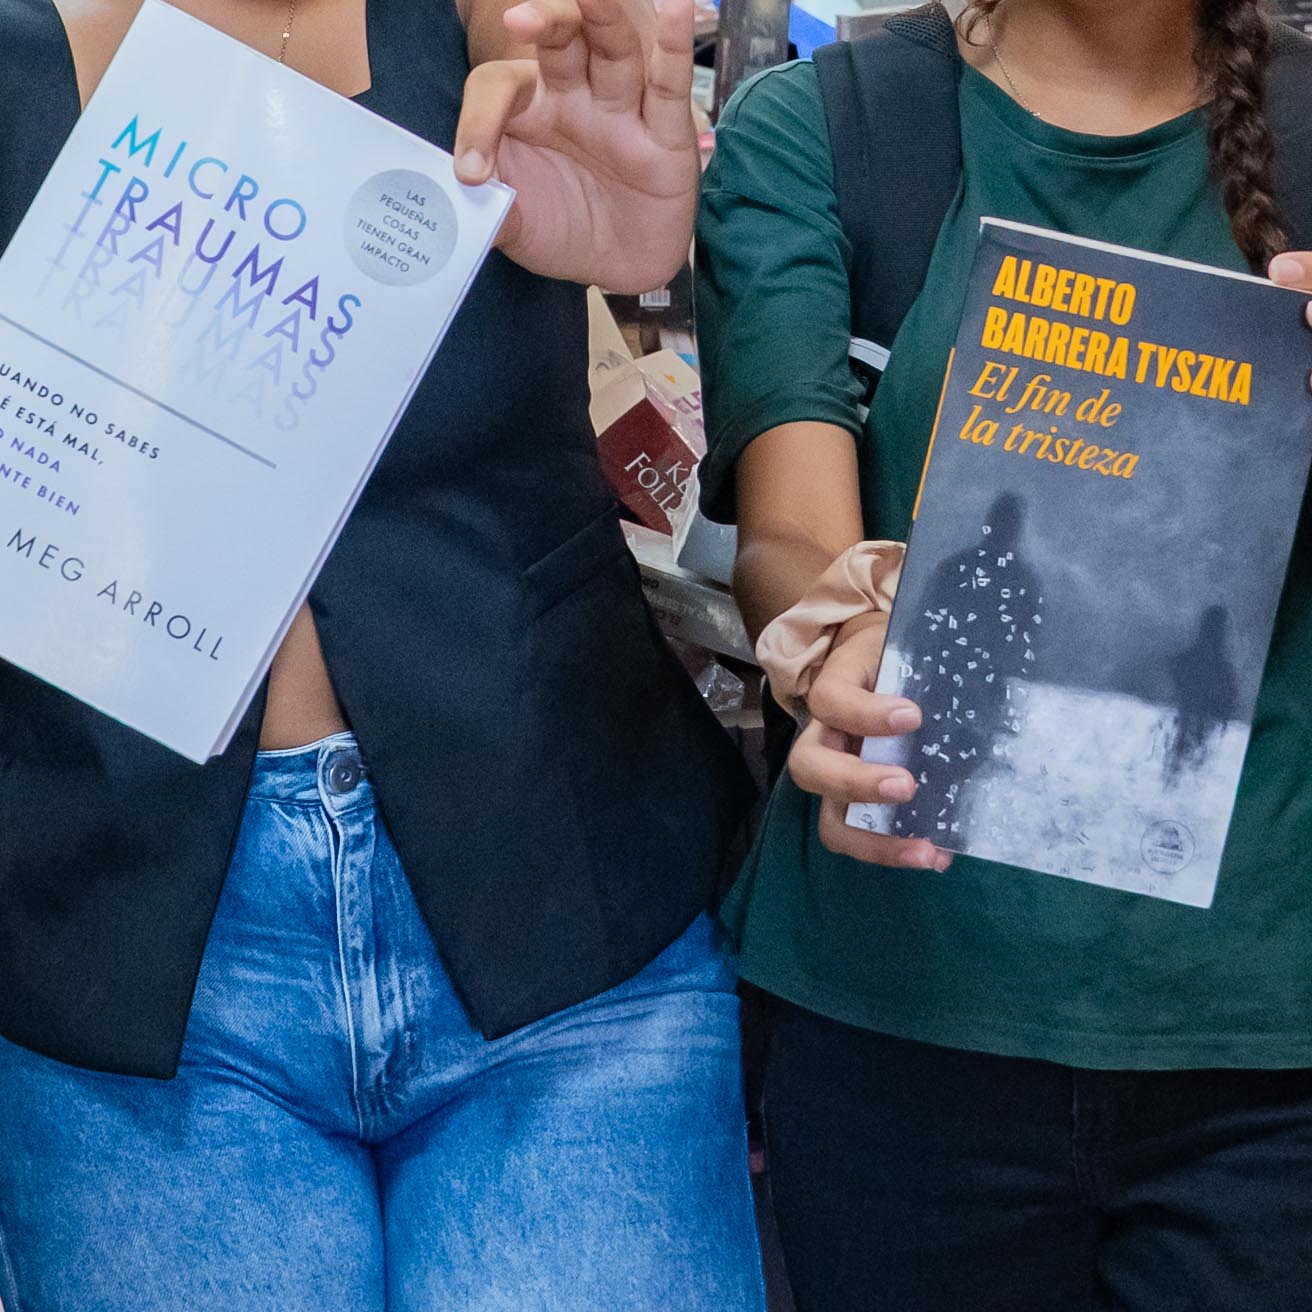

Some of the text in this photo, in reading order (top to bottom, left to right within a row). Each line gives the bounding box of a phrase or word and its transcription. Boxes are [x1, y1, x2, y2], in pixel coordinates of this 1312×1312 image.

[111, 114, 307, 241] MICRO
[406, 189, 427, 207] LAS
[356, 218, 431, 265] TIENEN GRAN
[378, 193, 438, 232] PEQUEÑAS
[382, 215, 421, 241] COSAS
[88, 158, 362, 335] TRAUMAS
[360, 240, 410, 272] IMPACTO
[992, 255, 1137, 326] ALBERTO
[981, 305, 1253, 406] BARRERA TYSZKA
[968, 360, 1122, 428] El fin de
[10, 437, 63, 473] NADA
[15, 406, 56, 438] ESTÁ
[61, 432, 105, 467] MAL,
[70, 404, 99, 426] NO
[104, 422, 162, 461] SABES
[959, 405, 1140, 479] la tristeza
[36, 485, 82, 516] BIEN
[7, 527, 86, 582] MEG
[96, 579, 225, 661] ARROLL
